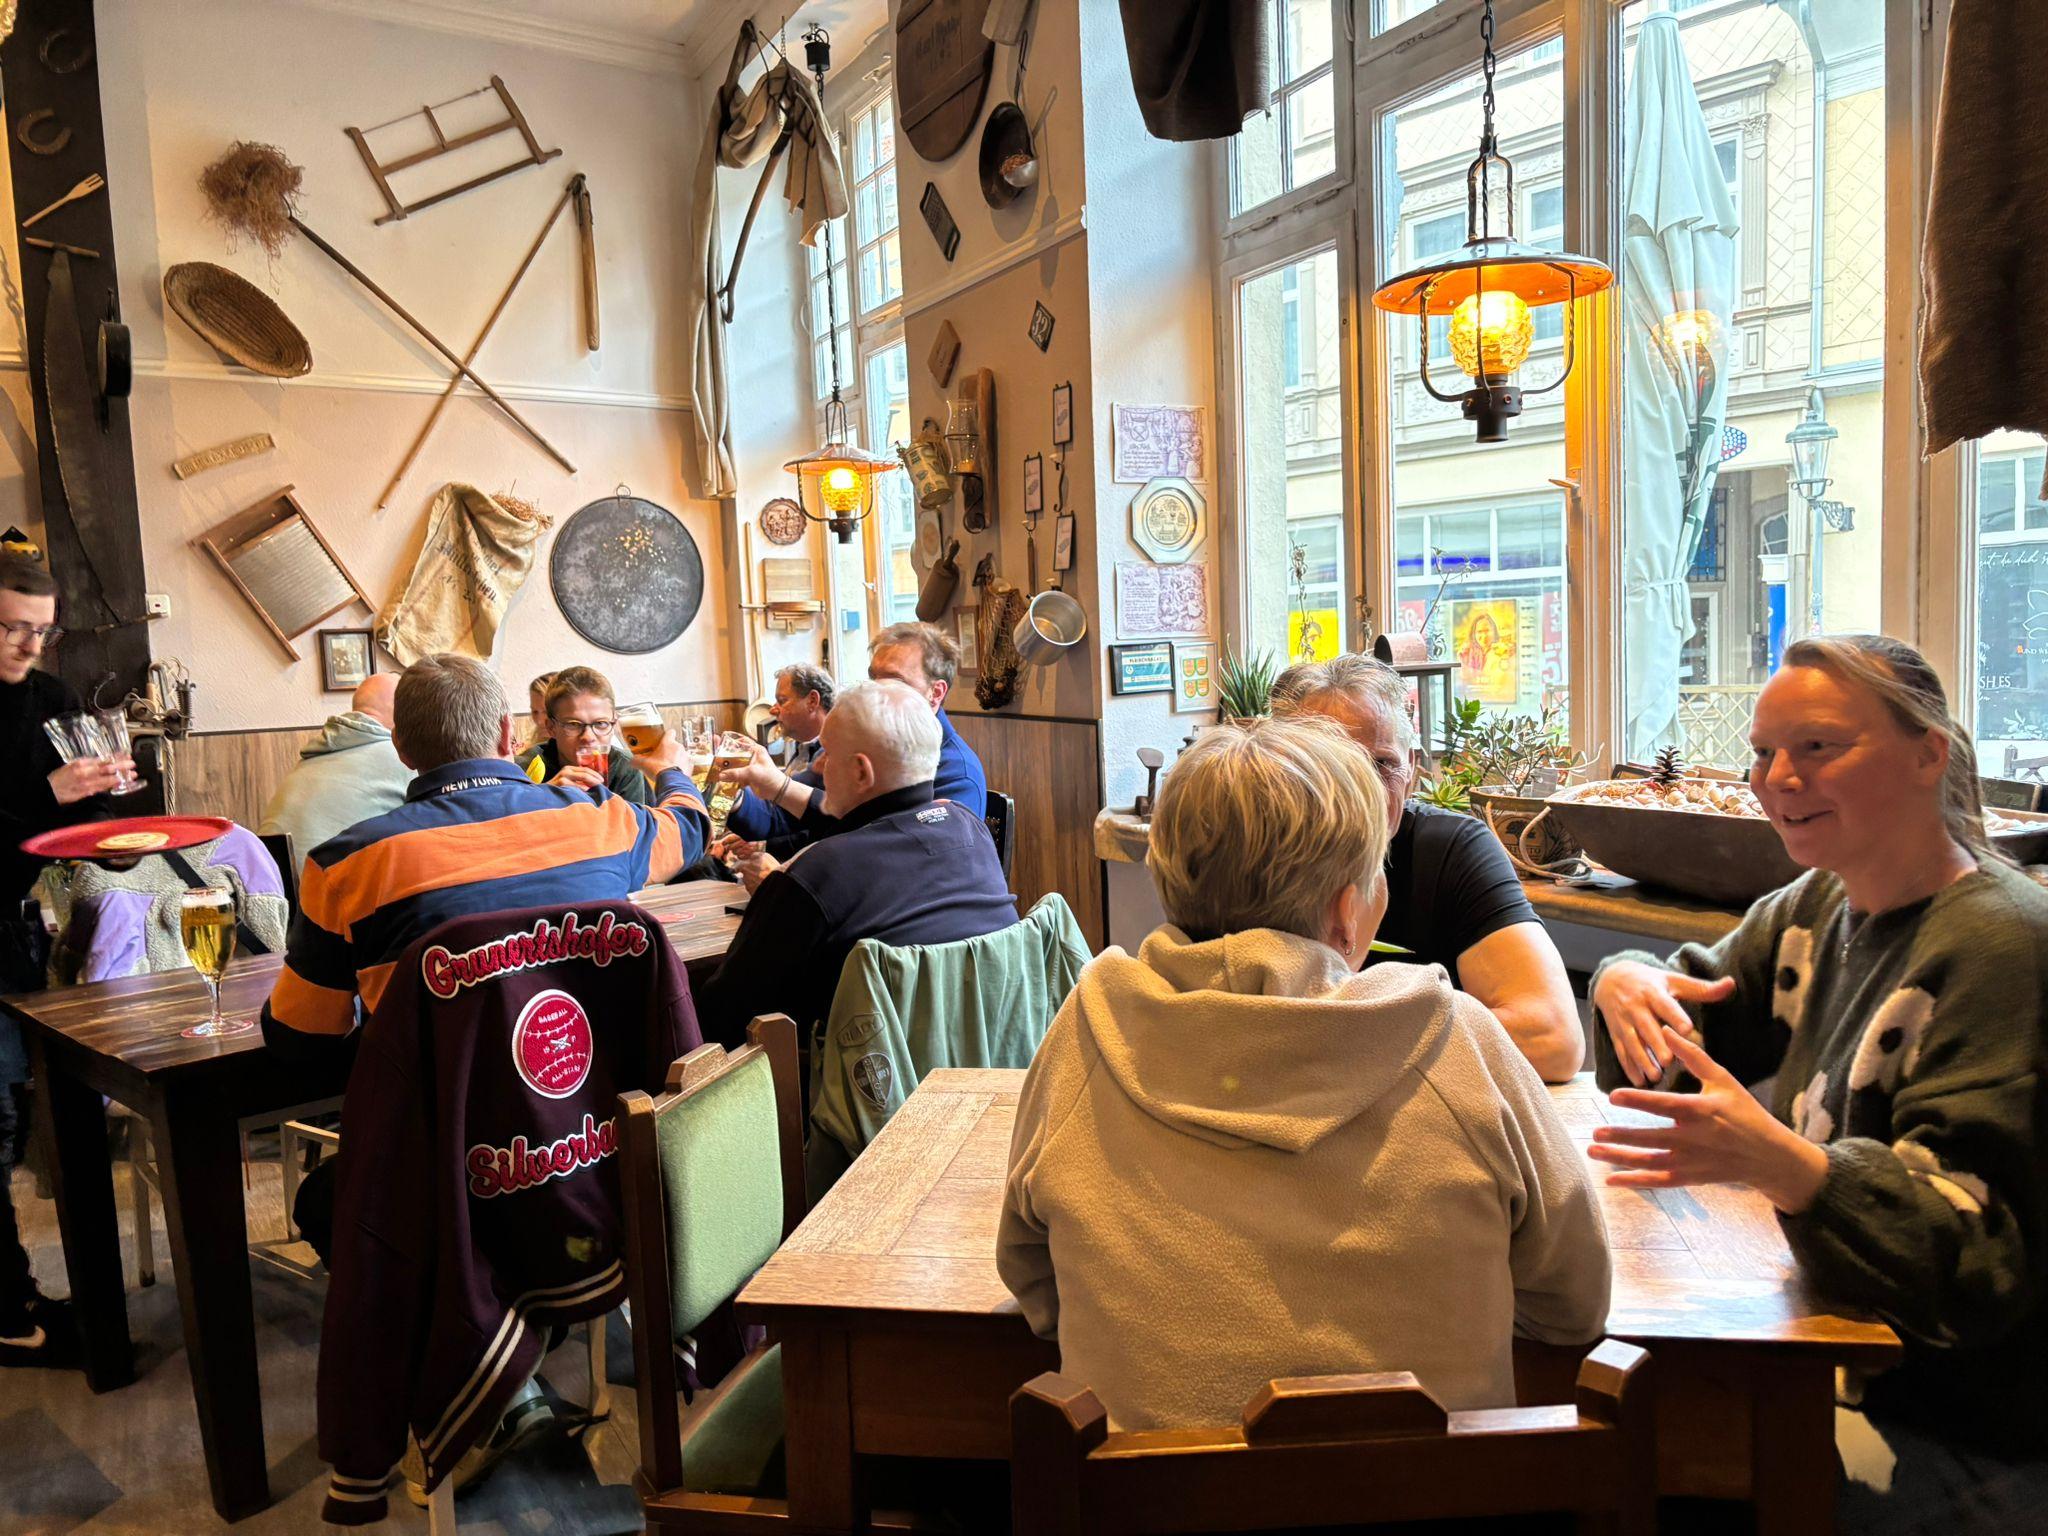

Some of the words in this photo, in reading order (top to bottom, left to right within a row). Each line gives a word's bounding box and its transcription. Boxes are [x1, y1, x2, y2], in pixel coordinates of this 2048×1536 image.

[1031, 310, 1048, 342] 32
[441, 779, 468, 793] NEW
[472, 776, 502, 788] YORK
[538, 1008, 568, 1024] BASEBALL
[466, 1113, 618, 1198] Silverba
